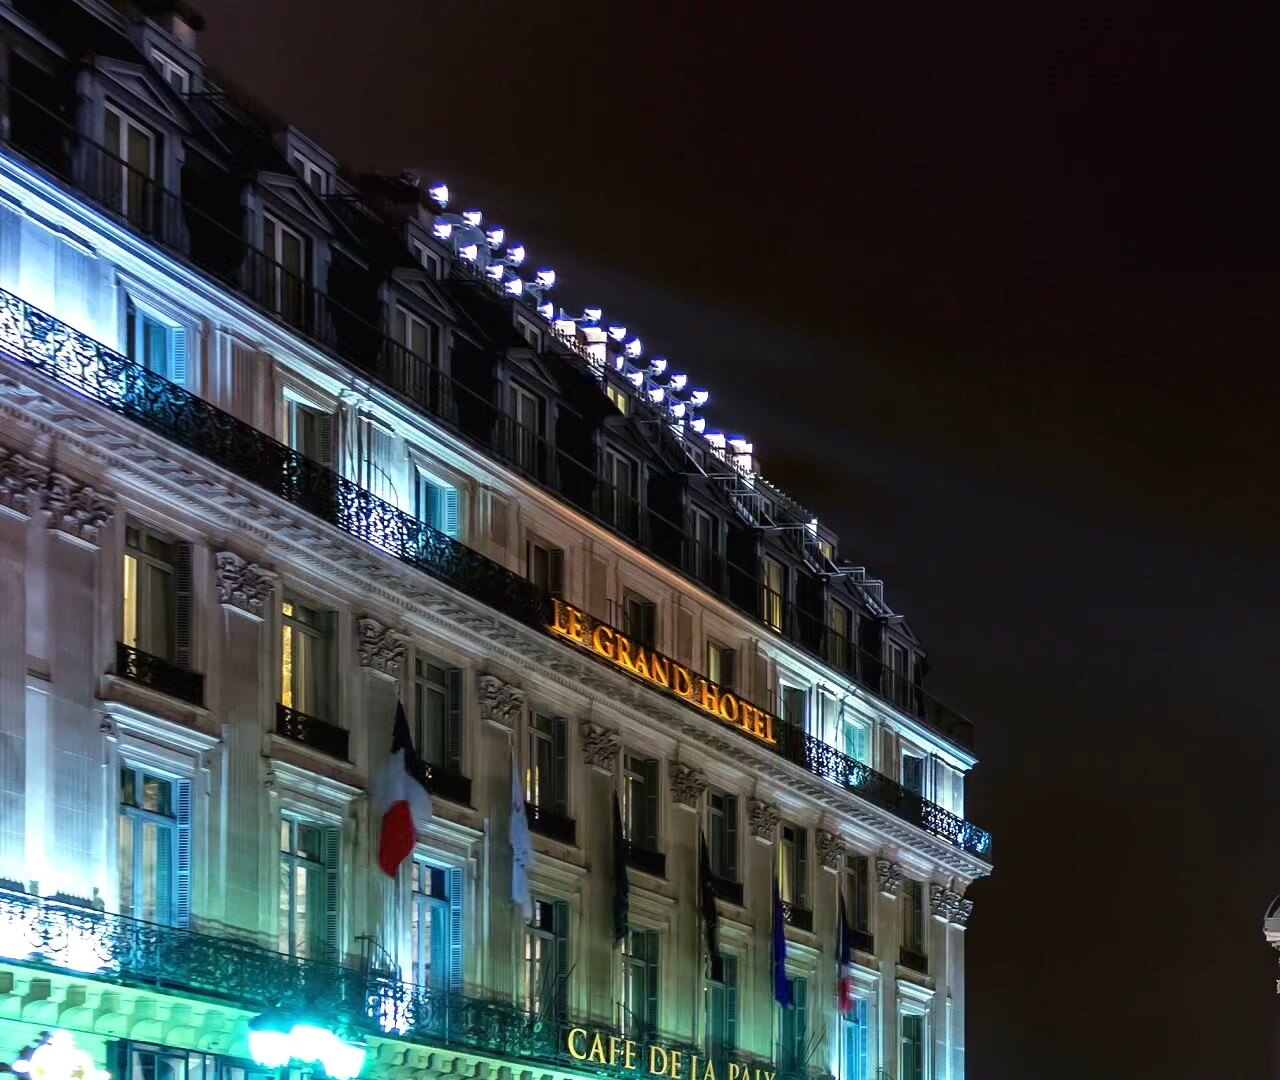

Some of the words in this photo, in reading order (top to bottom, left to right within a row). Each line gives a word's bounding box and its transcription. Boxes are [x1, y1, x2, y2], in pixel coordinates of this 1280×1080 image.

[550, 598, 583, 643] LE
[593, 625, 692, 697] GRAND
[699, 678, 777, 745] HOTEL
[567, 1028, 636, 1070] CAFE
[650, 1045, 682, 1079] DE
